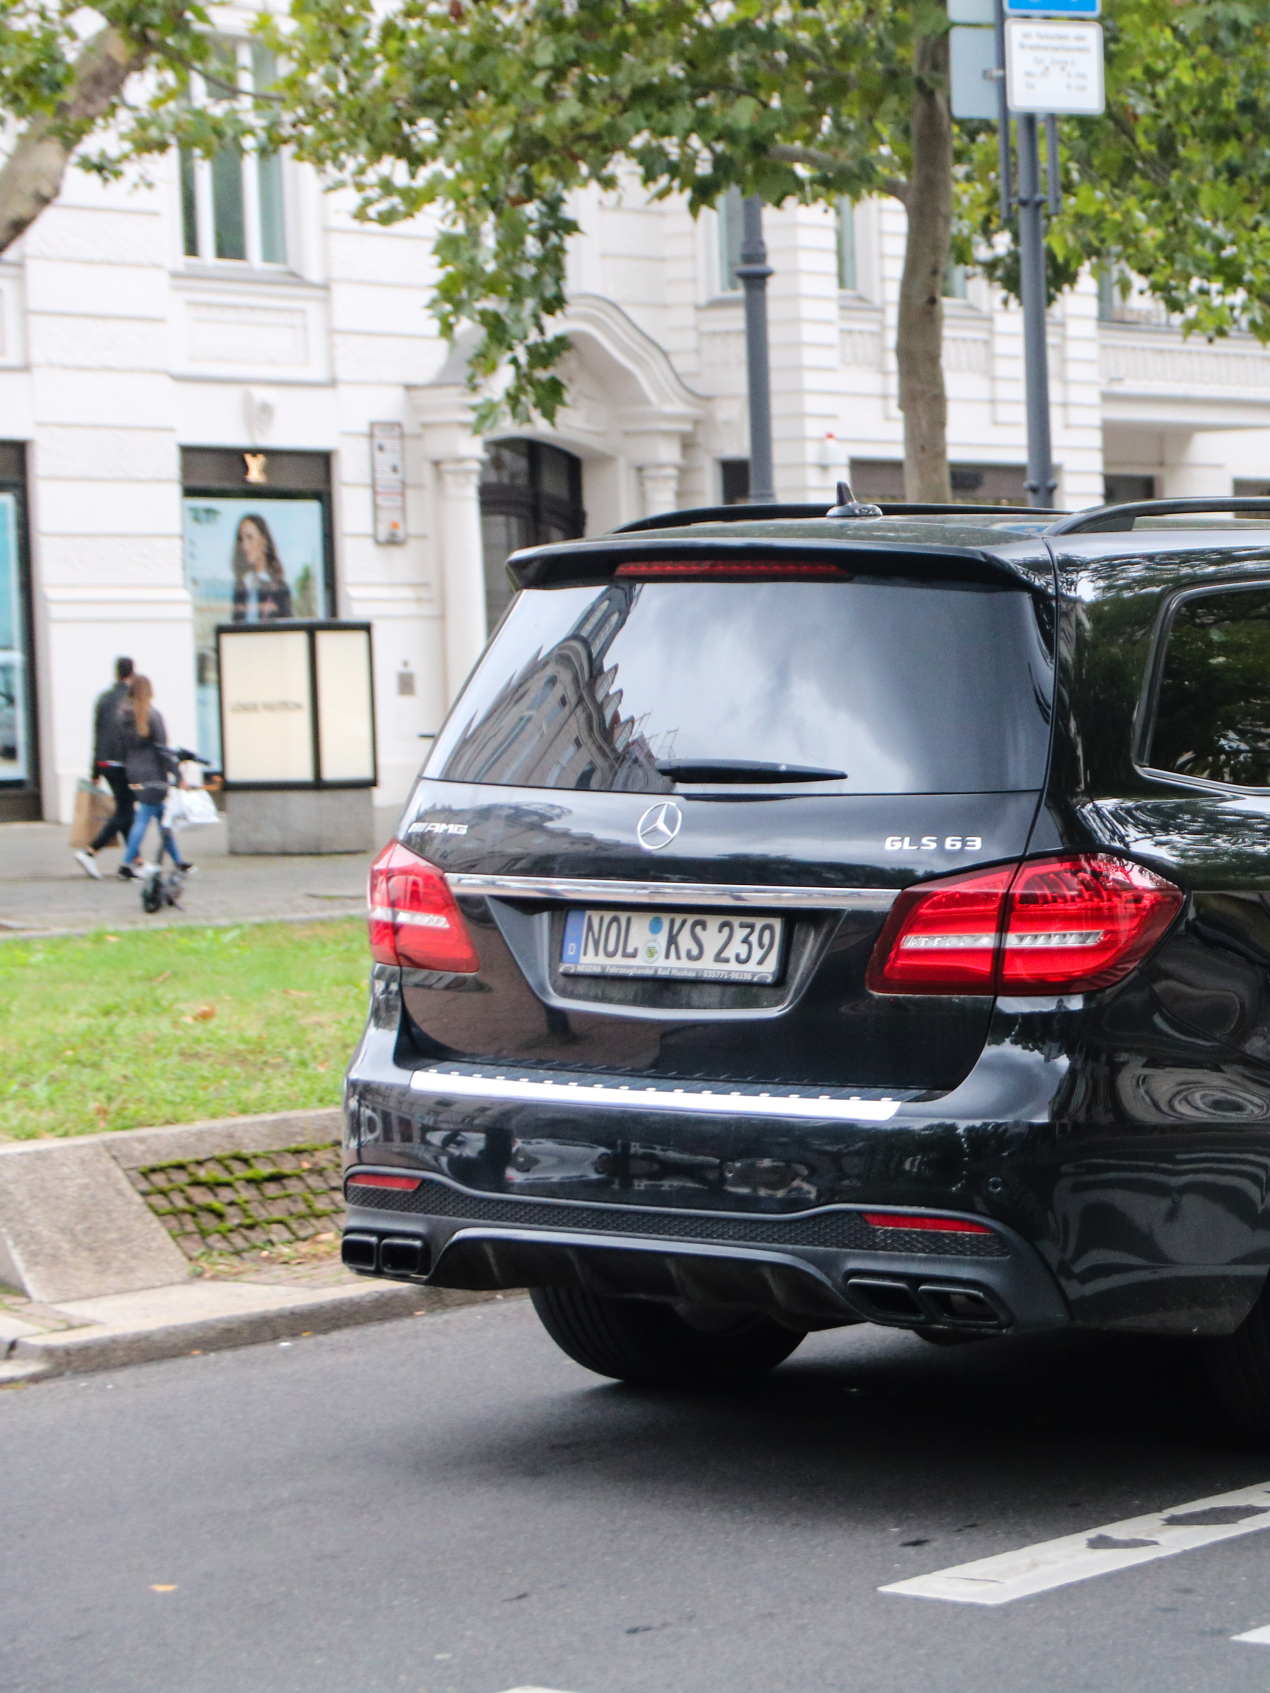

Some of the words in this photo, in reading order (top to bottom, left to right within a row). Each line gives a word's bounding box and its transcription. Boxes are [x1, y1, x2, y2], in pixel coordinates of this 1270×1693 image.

[424, 822, 468, 835] AMG
[884, 836, 938, 850] GLS
[944, 836, 982, 850] 63
[583, 914, 638, 959] NOL
[665, 917, 707, 961] KS
[713, 920, 776, 966] 239
[568, 944, 576, 955] D
